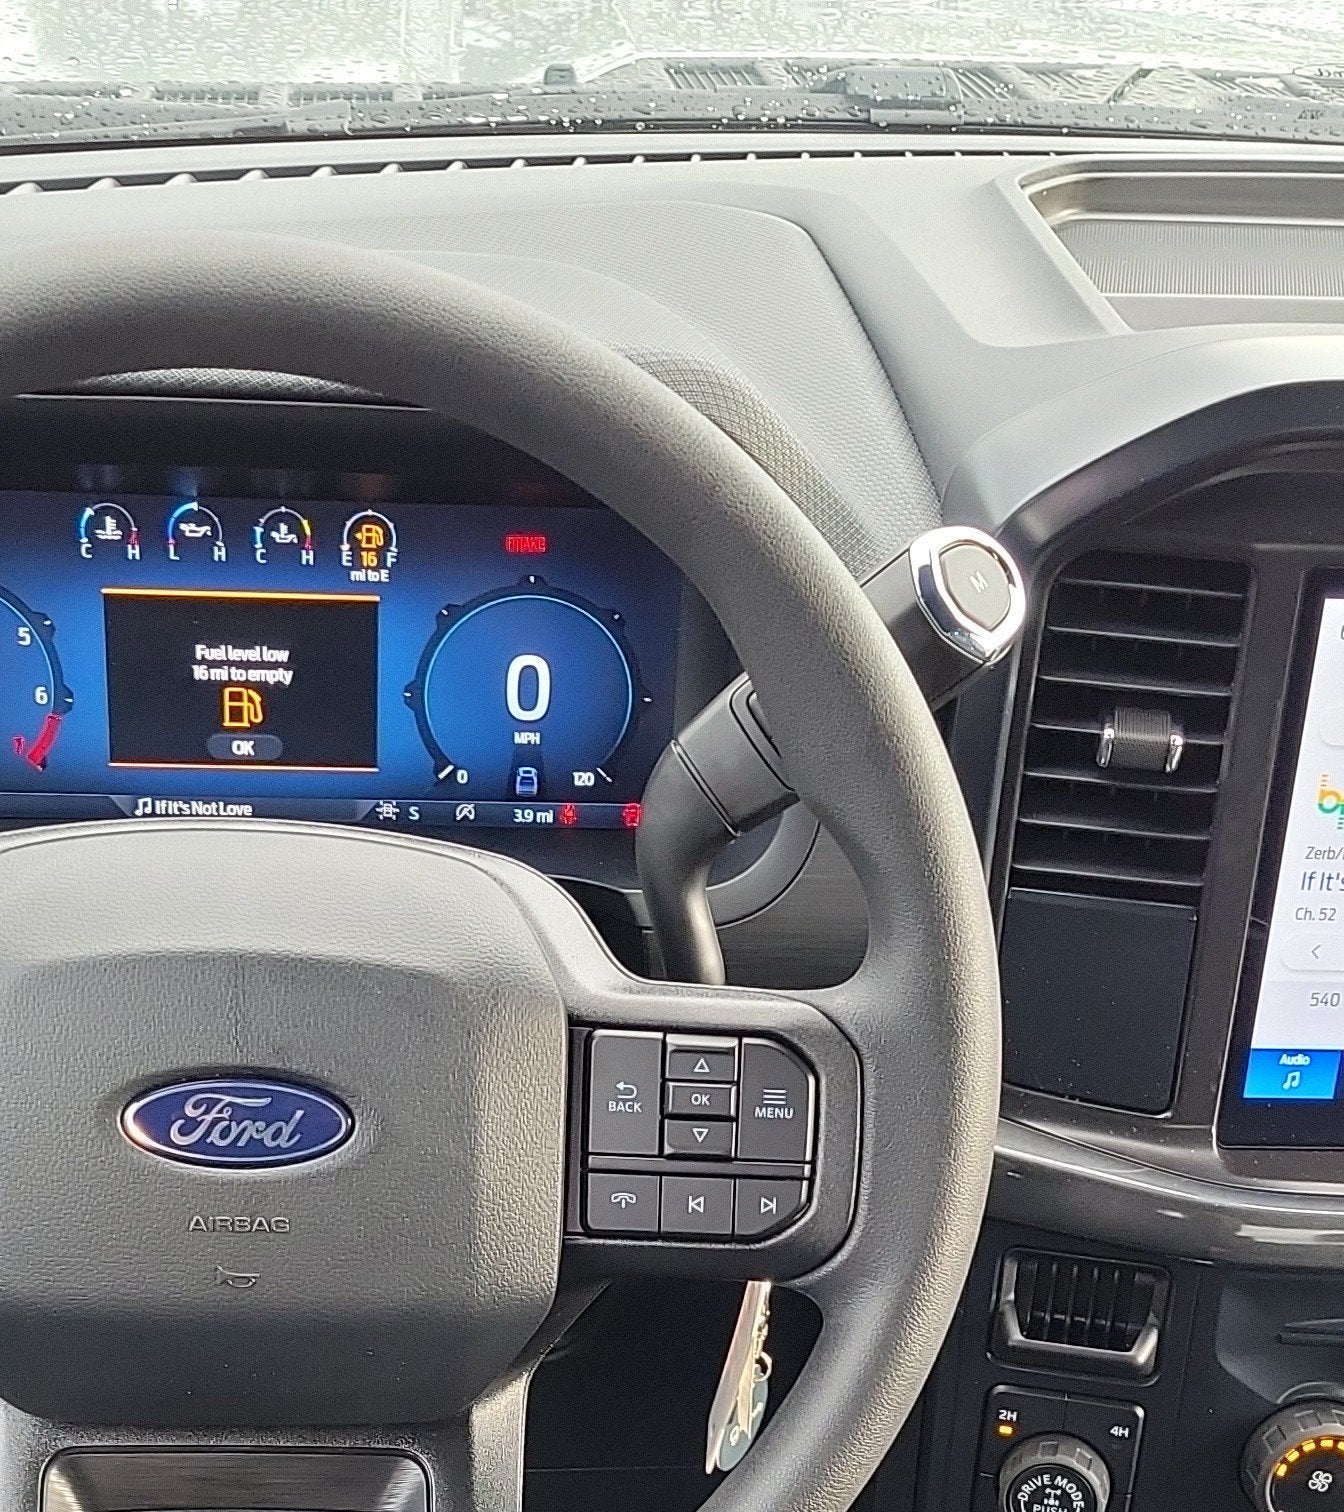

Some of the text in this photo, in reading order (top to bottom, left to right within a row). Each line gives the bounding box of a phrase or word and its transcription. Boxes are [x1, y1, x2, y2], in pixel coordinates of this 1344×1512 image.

[80, 543, 93, 560] C
[127, 545, 140, 561] H
[169, 545, 180, 561] L
[213, 547, 226, 562] H
[255, 549, 267, 564] C
[301, 550, 314, 566] H
[341, 551, 352, 567] E
[360, 552, 377, 567] 16
[386, 552, 398, 567] F
[381, 570, 390, 583] E
[969, 571, 988, 593] M
[17, 627, 31, 646] 5
[195, 644, 289, 663] Fuel level low
[191, 664, 294, 686] 16 mi to empty
[506, 653, 551, 722] 0
[35, 686, 48, 705] 6
[513, 732, 541, 745] MPH
[231, 740, 255, 756] OK
[456, 769, 469, 784] 0
[572, 771, 595, 786] 120
[154, 800, 253, 816] If It's Not Love
[408, 806, 420, 821] S
[513, 808, 553, 823] 3.9 mi
[1300, 872, 1317, 891] If
[1295, 907, 1337, 922] Ch. 52
[1309, 993, 1340, 1007] 540
[1279, 1053, 1311, 1067] Audio
[608, 1101, 643, 1113] BACK
[690, 1093, 711, 1106] OK
[169, 1092, 306, 1148] Ford
[755, 1107, 794, 1119] MENU
[188, 1215, 291, 1234] AIRBAG
[998, 1409, 1017, 1422] 2H
[1110, 1425, 1130, 1439] 4H
[1017, 1474, 1085, 1509] DRIVE MODE
